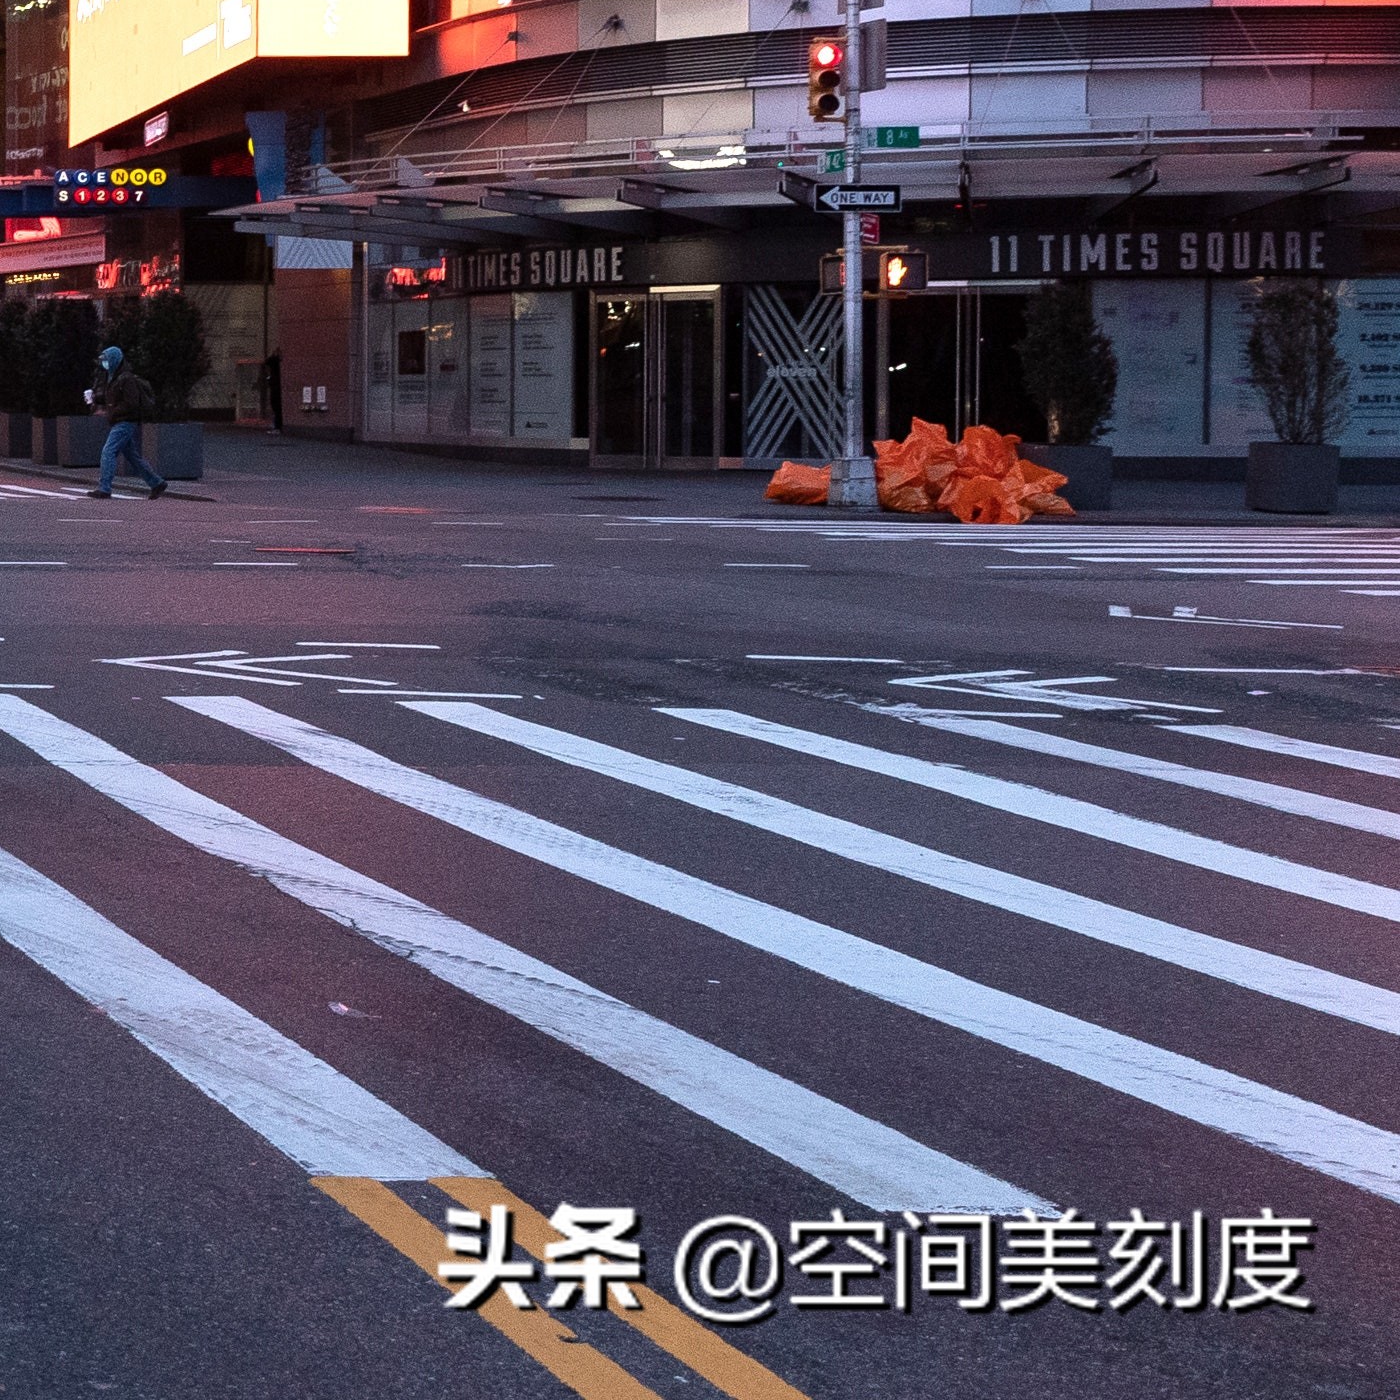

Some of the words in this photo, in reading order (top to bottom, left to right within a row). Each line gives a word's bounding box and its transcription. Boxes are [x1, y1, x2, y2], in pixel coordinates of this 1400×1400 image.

[885, 129, 894, 146] 8
[58, 171, 69, 183] A
[77, 171, 88, 183] C
[97, 171, 106, 183] E
[115, 171, 126, 183] N
[134, 171, 145, 184] Q
[153, 171, 163, 183] R
[58, 190, 68, 202] S
[830, 192, 858, 205] ONE
[863, 192, 890, 205] WAY
[990, 235, 1018, 275] 11
[1040, 232, 1159, 274] TIMES
[1179, 230, 1326, 273] SQUARE
[467, 252, 522, 287] TIMES
[529, 246, 624, 287] SQUARE
